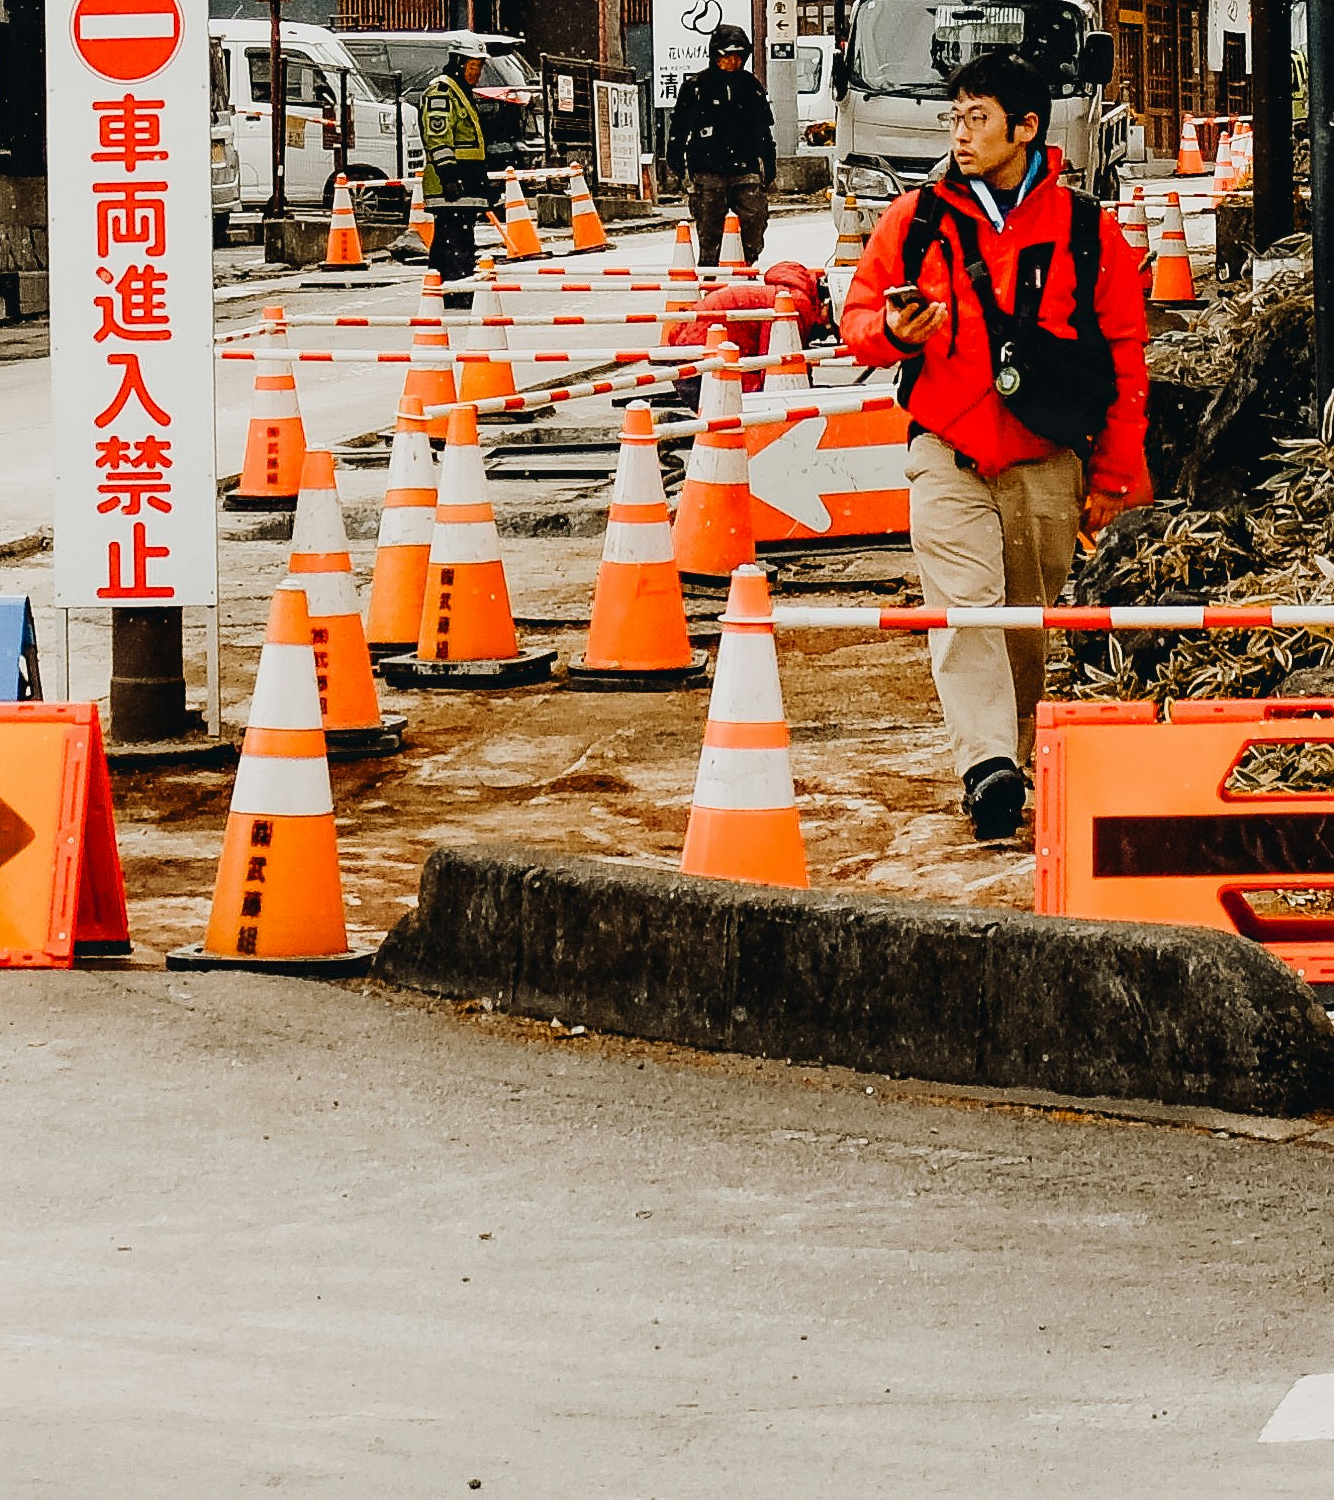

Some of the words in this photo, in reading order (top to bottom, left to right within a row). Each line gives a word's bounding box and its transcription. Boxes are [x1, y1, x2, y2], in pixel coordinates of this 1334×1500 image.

[91, 94, 176, 600] 車両進入禁止
